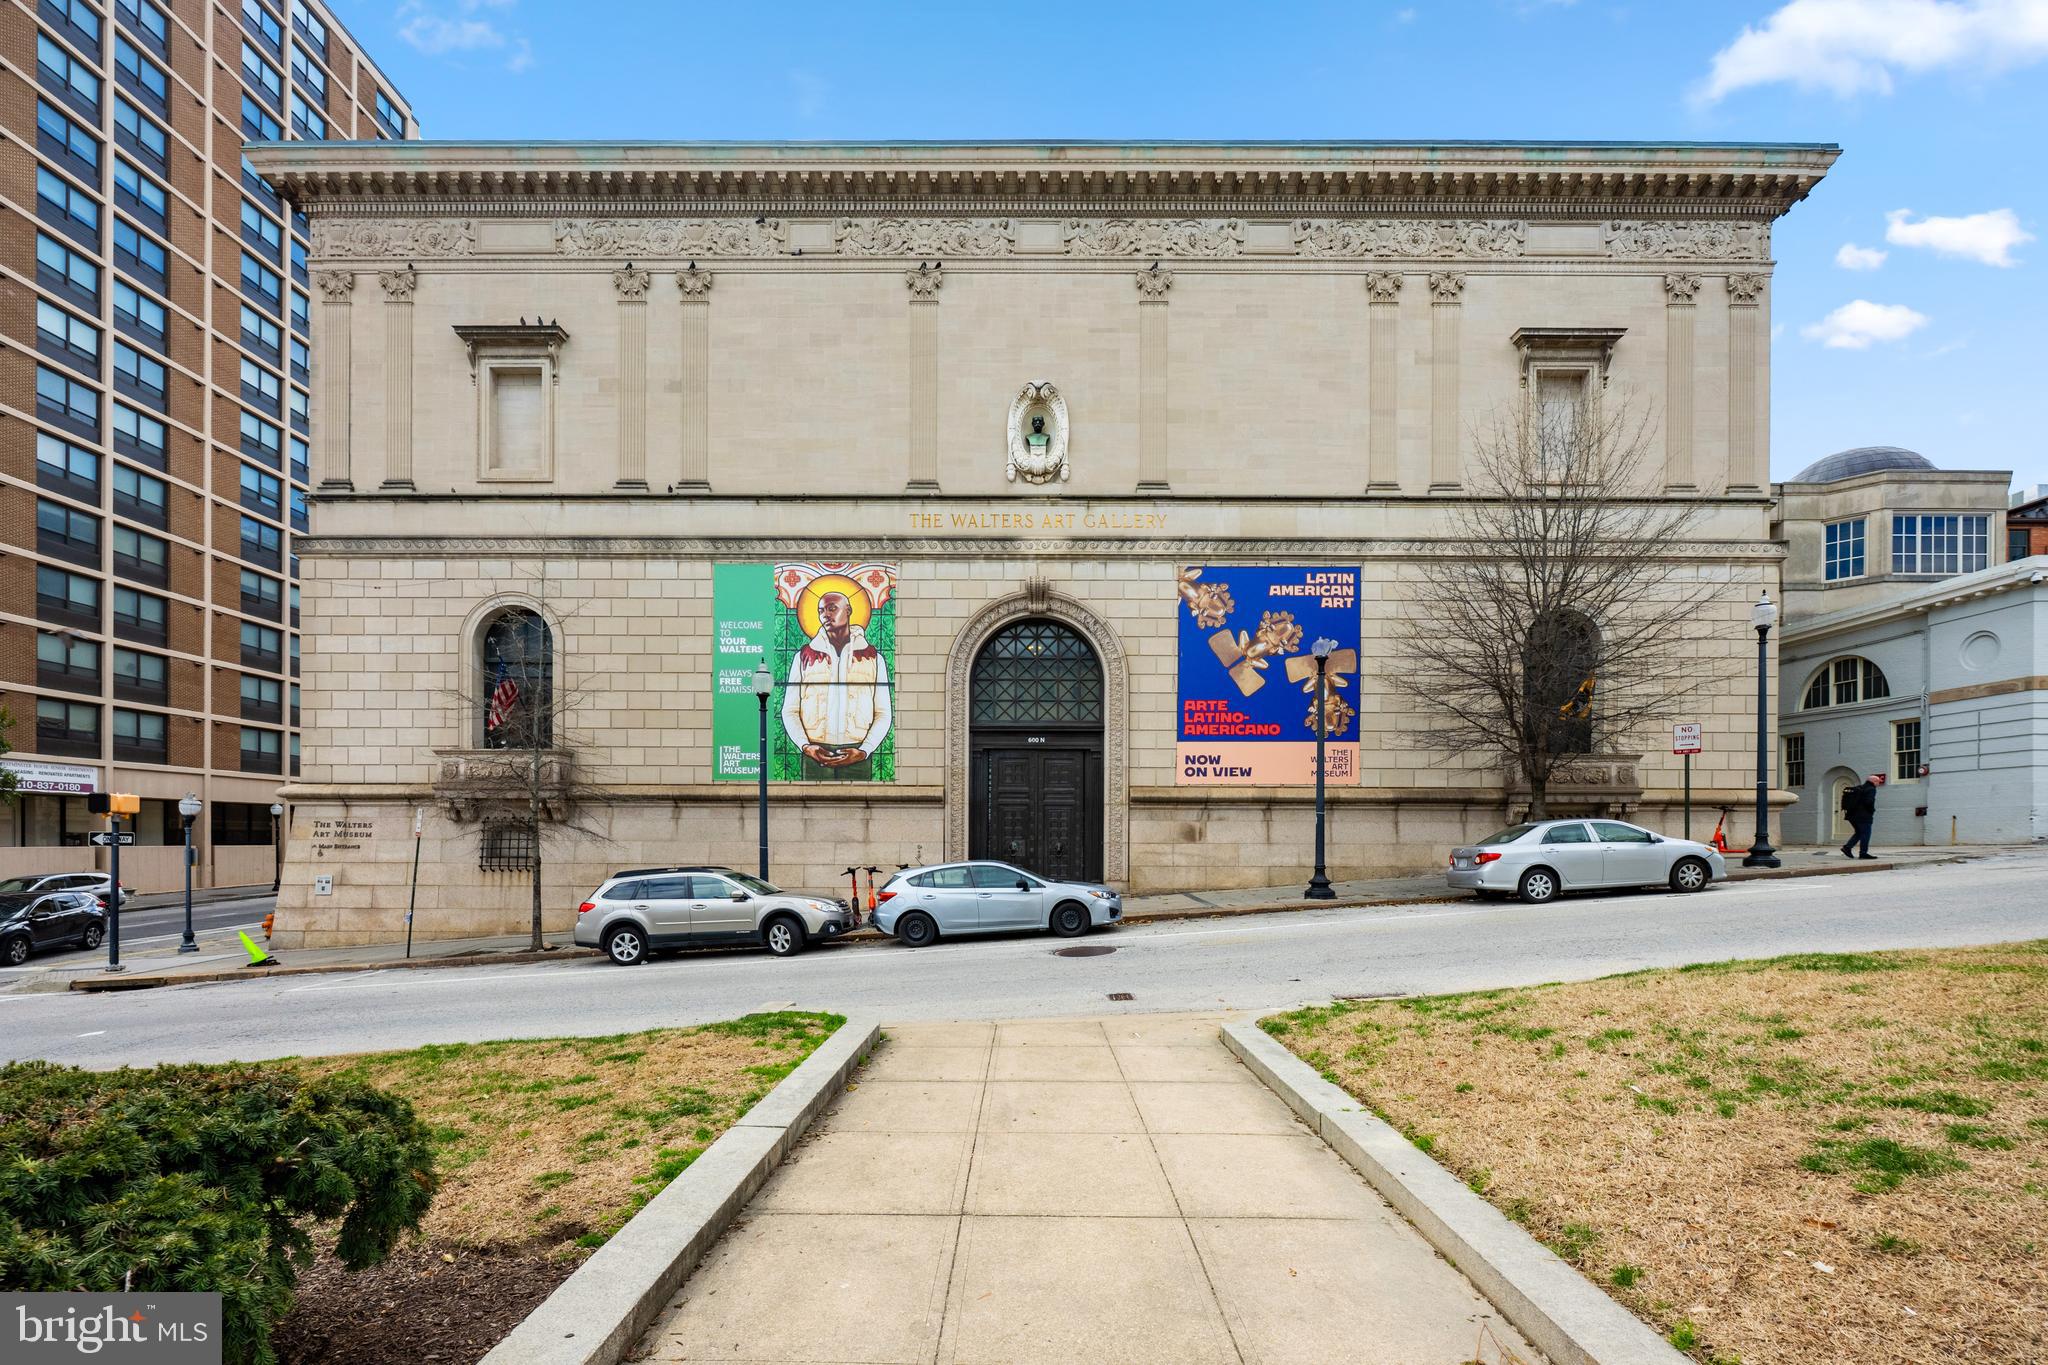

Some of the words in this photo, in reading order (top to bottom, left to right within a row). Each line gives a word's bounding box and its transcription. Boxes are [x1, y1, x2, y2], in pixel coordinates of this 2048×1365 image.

[909, 513, 943, 529] THE
[951, 513, 1033, 529] WALTERS
[1041, 513, 1075, 529] ART
[1083, 513, 1168, 529] GALLERY
[1306, 573, 1354, 584] LATIN
[1269, 585, 1354, 596] AMERICAN
[1320, 597, 1354, 608] ART
[720, 620, 763, 629] WELCOME
[720, 629, 731, 637] TO
[720, 637, 747, 645] YOUR
[719, 645, 764, 653] WALTERS
[719, 670, 753, 678] ALWAYS
[719, 677, 742, 685] FREE
[719, 685, 758, 694] ADMISSI
[1184, 700, 1228, 711] ARTE
[1184, 712, 1250, 723] LATINO-
[1184, 724, 1281, 736] AMERICANO
[723, 745, 741, 753] THE
[723, 752, 760, 760] WALTERS
[1185, 754, 1221, 766] NOW
[723, 766, 760, 774] MUSEUM
[1184, 766, 1208, 777] ON
[1213, 766, 1252, 777] VIEW
[313, 820, 331, 828] THE
[335, 820, 373, 828] WALTERS
